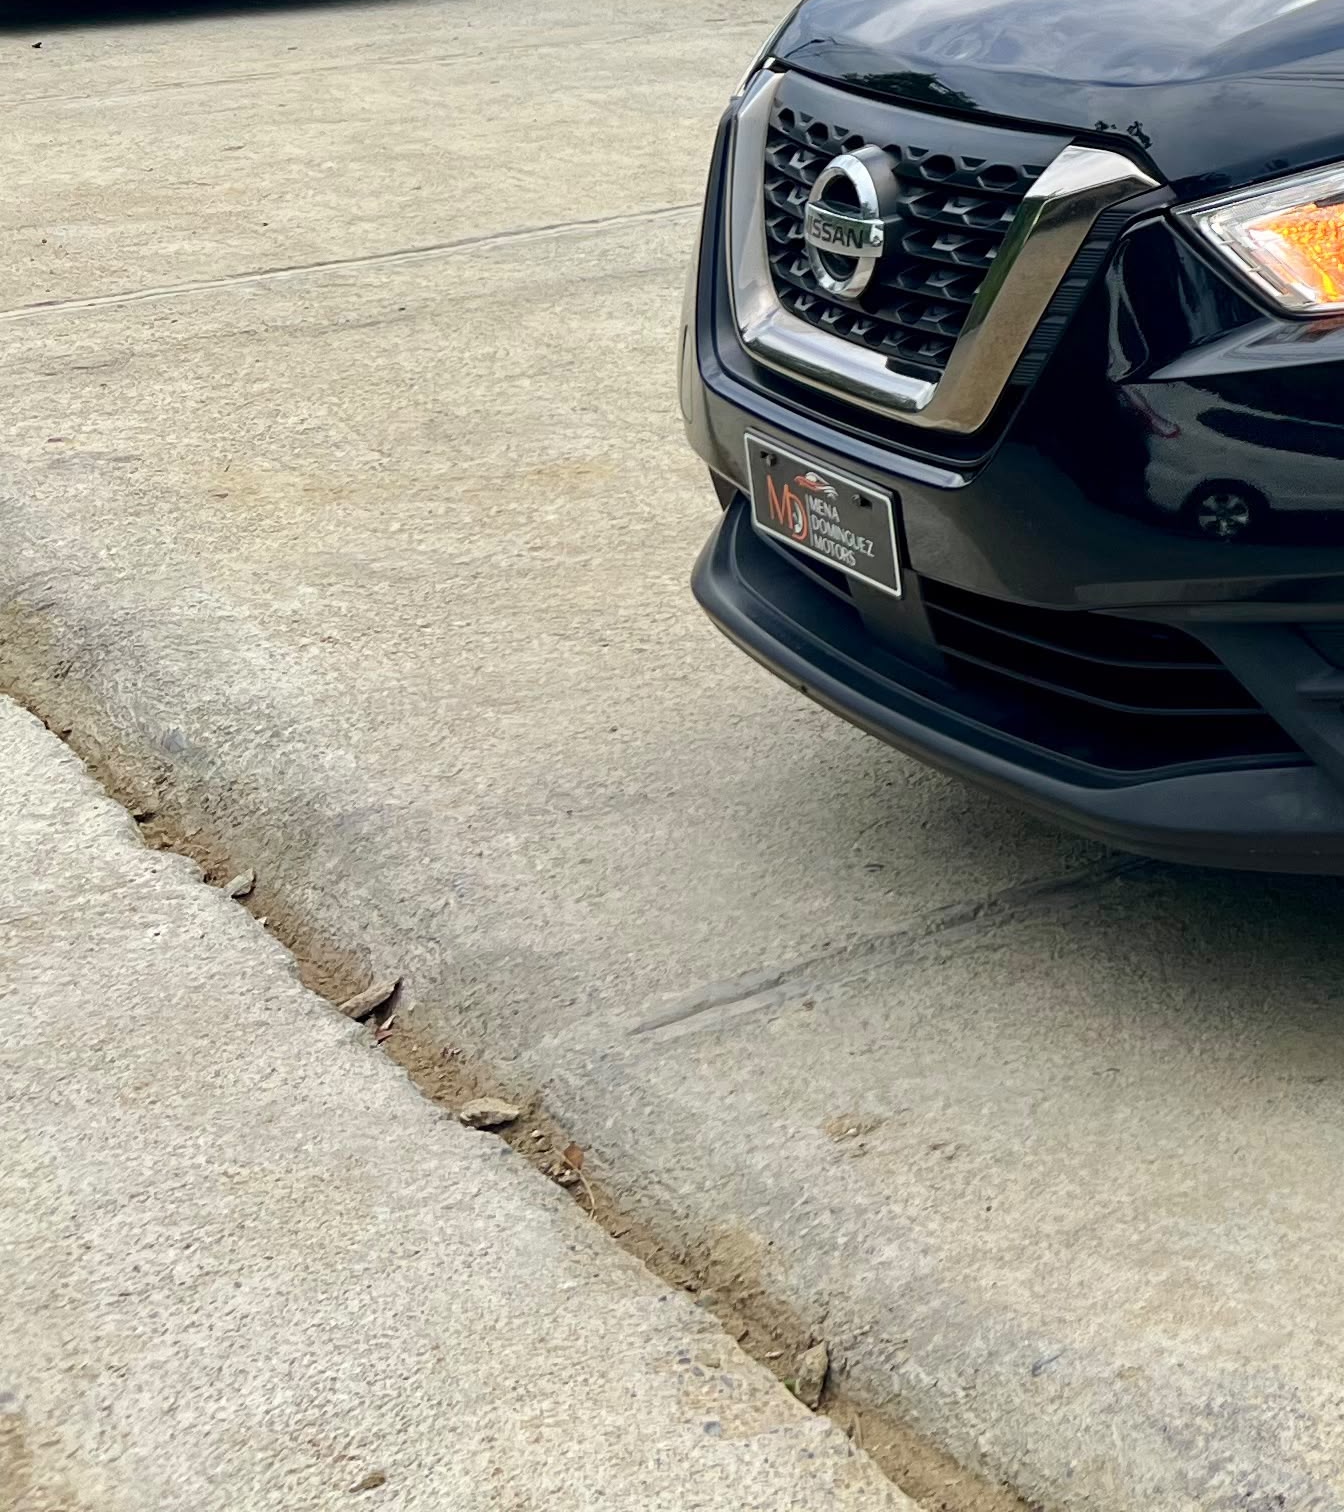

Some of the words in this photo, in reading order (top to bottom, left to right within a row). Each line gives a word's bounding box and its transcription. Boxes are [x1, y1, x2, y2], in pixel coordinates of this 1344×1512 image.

[809, 495, 840, 523] MENA
[811, 514, 875, 558] DOMINGUEZ
[813, 534, 856, 567] MOTORS
